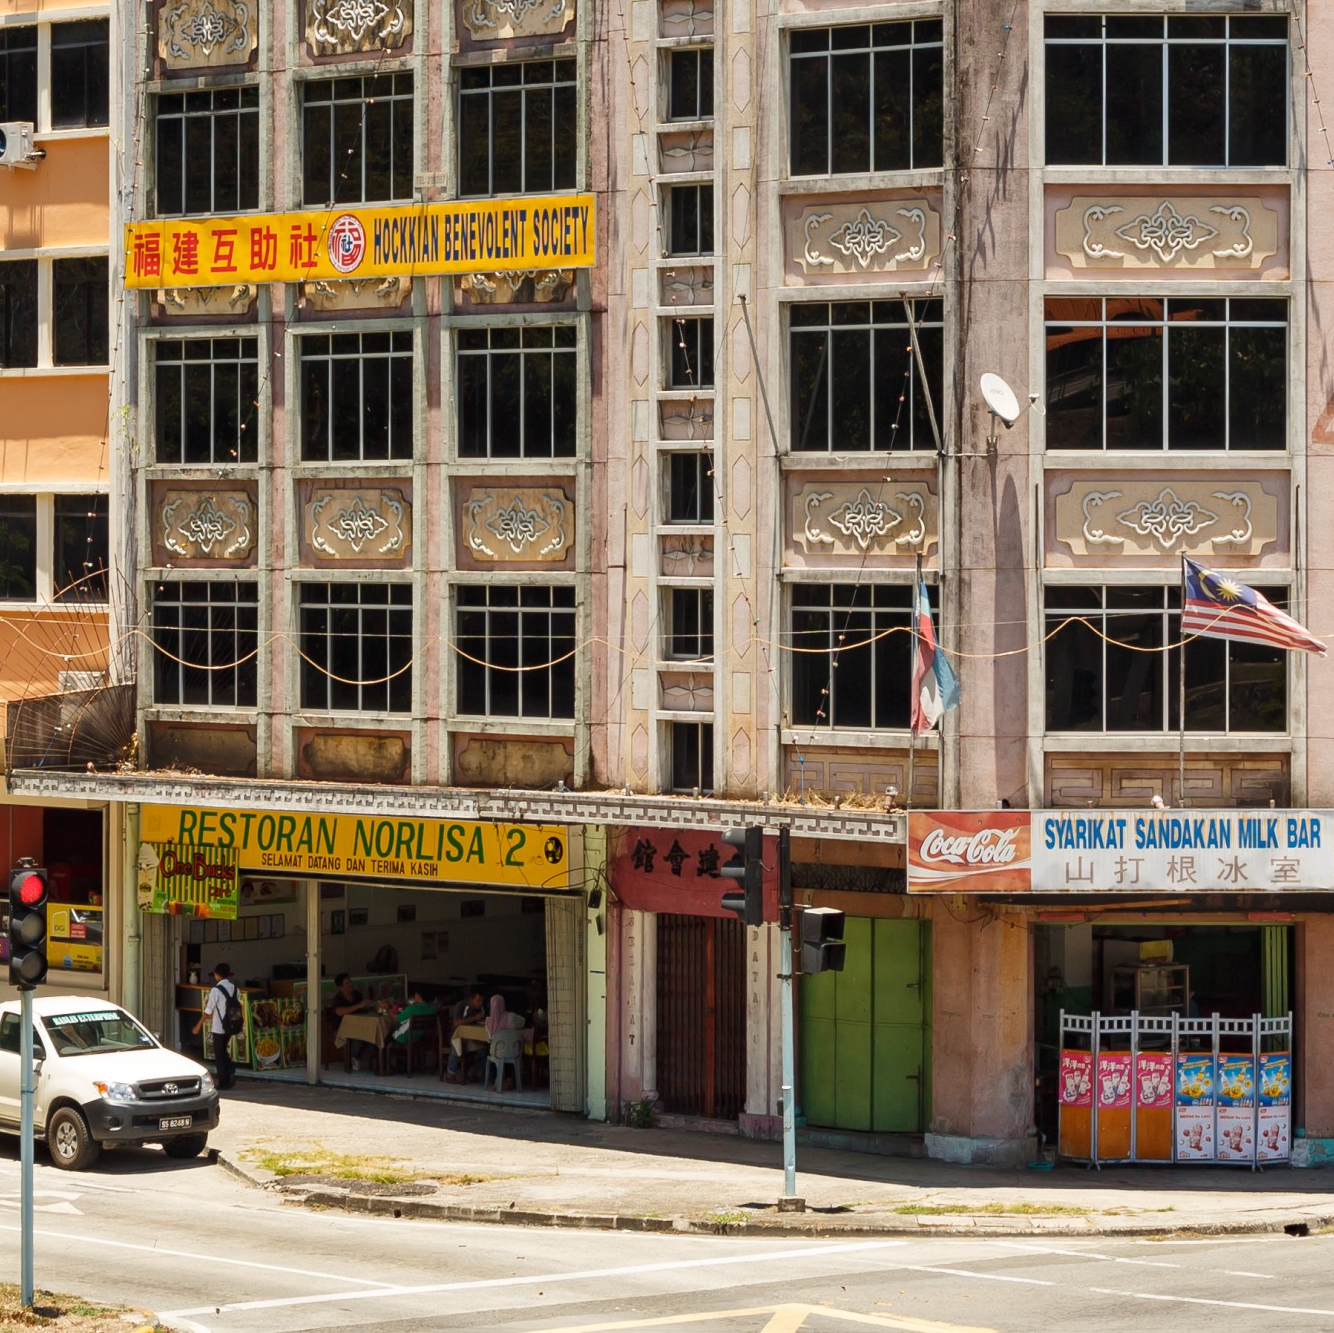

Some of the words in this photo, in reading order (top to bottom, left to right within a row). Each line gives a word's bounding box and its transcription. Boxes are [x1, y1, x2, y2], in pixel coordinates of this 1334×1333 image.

[133, 223, 318, 277] 福建互助社
[373, 215, 439, 265] HOCKKIAN
[444, 210, 527, 261] BENEVOLENT
[533, 205, 589, 257] SOCIETY
[178, 810, 338, 854] RESTORAN
[353, 818, 485, 864] NORLISA
[505, 828, 526, 867] 2
[919, 827, 1020, 865] Coca-Cola
[1044, 819, 1126, 850] SYARIKAT
[1135, 819, 1231, 850] SANDAKAN
[1238, 818, 1278, 849] MILK
[1287, 818, 1321, 849] BAR
[261, 853, 303, 868] SELAMAT
[308, 855, 341, 871] DATANG
[346, 858, 365, 872] DAN
[371, 859, 405, 875] TERIMA
[411, 862, 438, 876] KASIH
[1065, 854, 1301, 884] 山打根冰室
